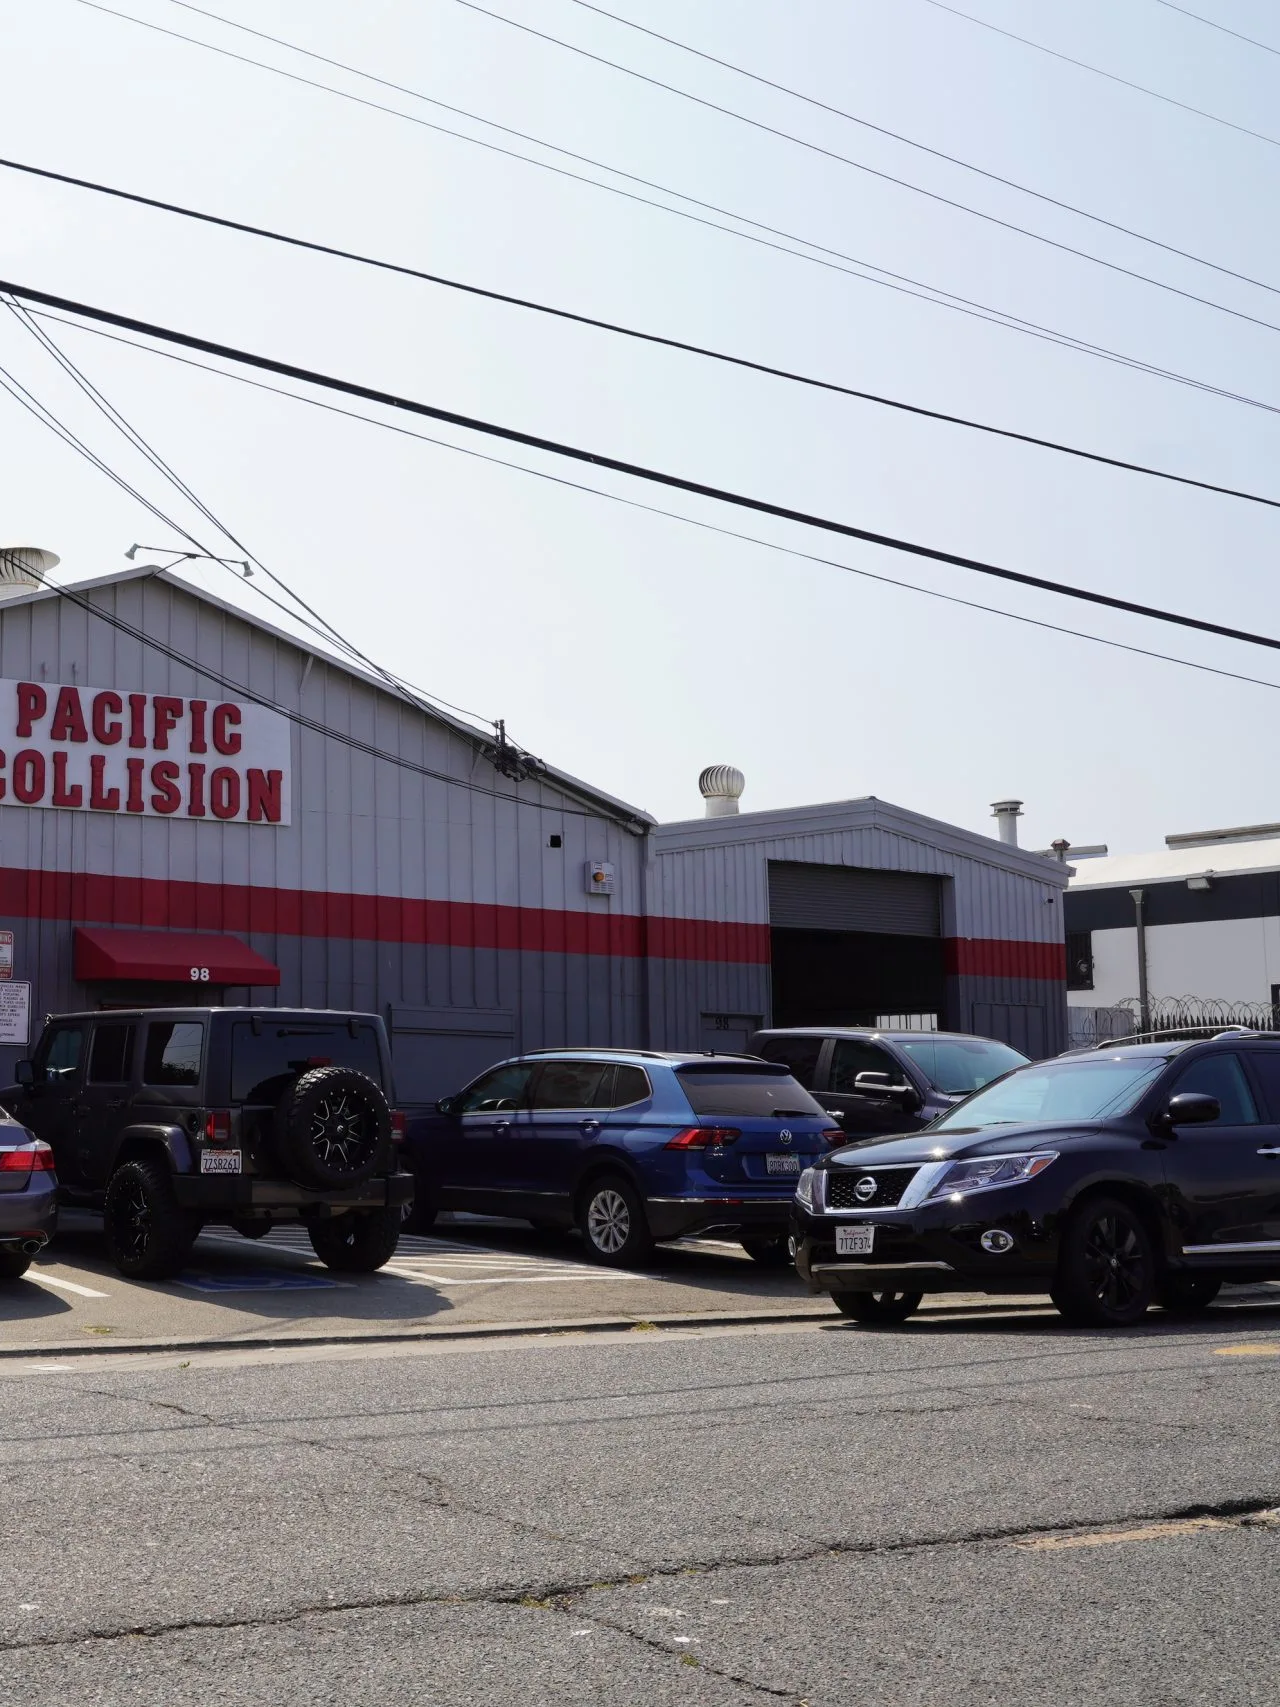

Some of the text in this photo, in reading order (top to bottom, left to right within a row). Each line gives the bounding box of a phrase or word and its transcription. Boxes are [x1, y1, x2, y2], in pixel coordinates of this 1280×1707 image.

[16, 682, 242, 756] PACIFIC
[190, 967, 210, 981] 98
[839, 1237, 871, 1250] 7TZF374
